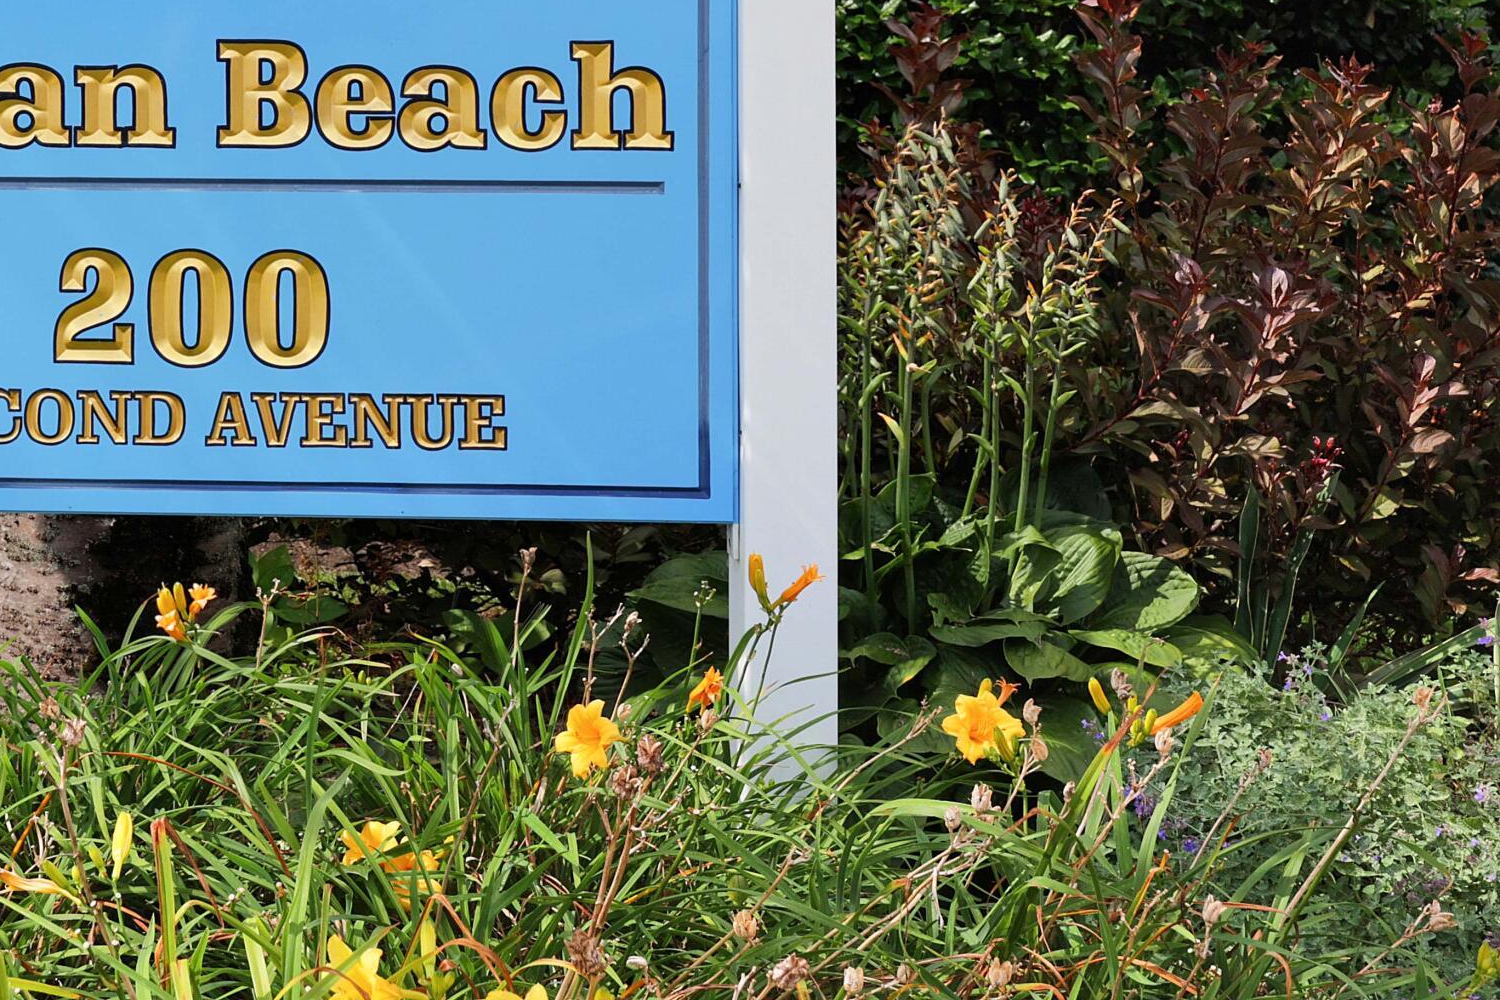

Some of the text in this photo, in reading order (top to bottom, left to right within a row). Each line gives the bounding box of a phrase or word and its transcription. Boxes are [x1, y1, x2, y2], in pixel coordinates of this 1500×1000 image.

[215, 38, 675, 152] Beach
[52, 247, 331, 369] 200
[204, 392, 508, 452] AVENUE
